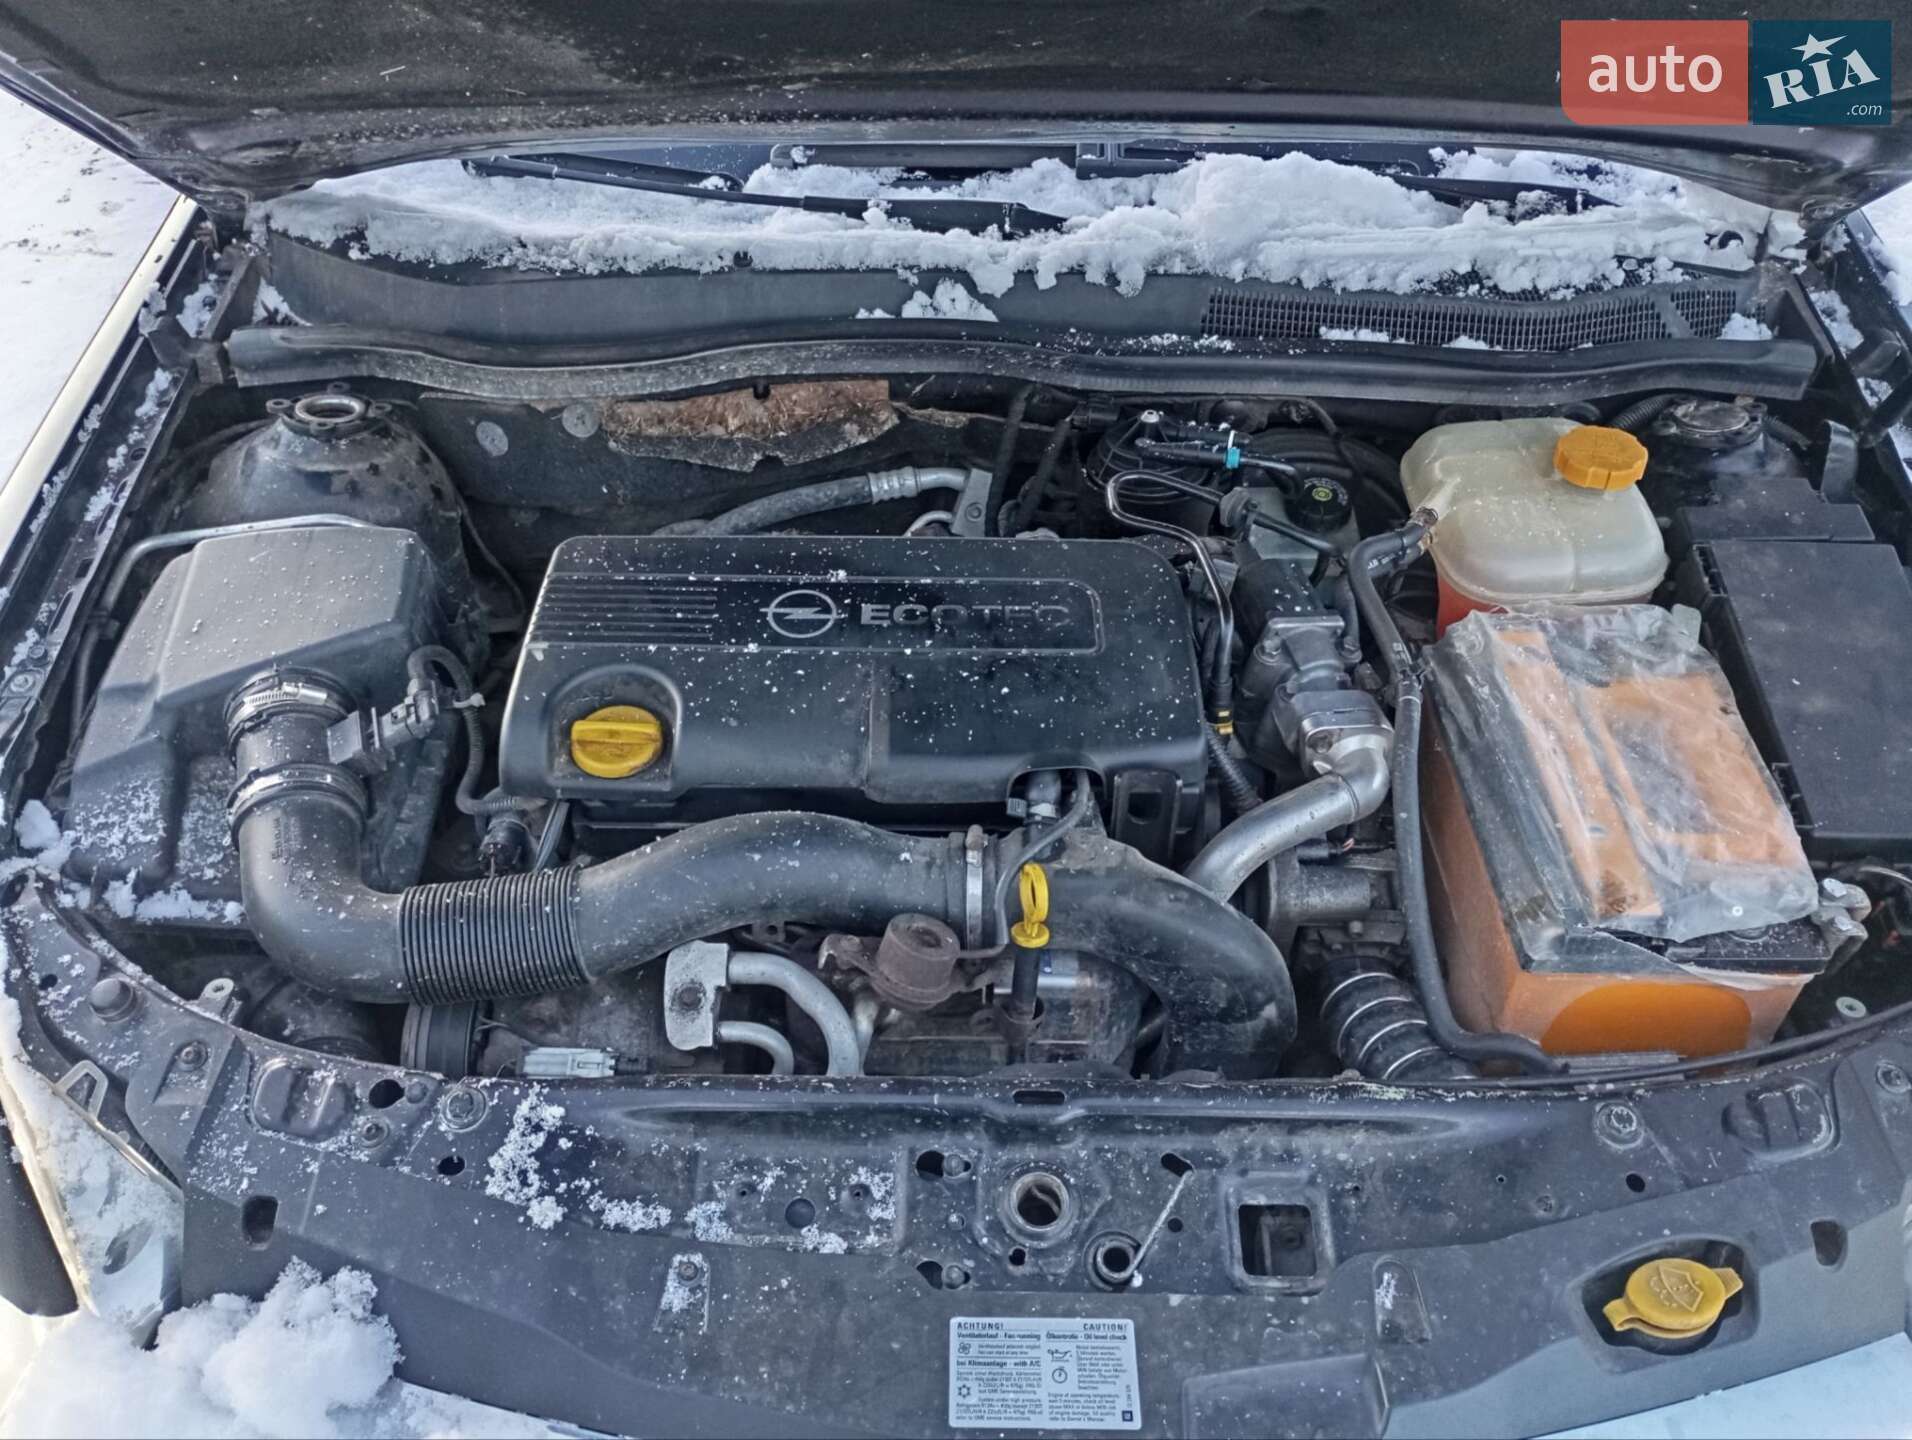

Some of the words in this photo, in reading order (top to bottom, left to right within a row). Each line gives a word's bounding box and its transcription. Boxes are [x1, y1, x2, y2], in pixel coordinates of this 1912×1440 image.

[860, 603, 1070, 627] ECOTEC
[957, 1322, 1004, 1331] ACHTUNG!
[1083, 1323, 1127, 1332] CAUTION!
